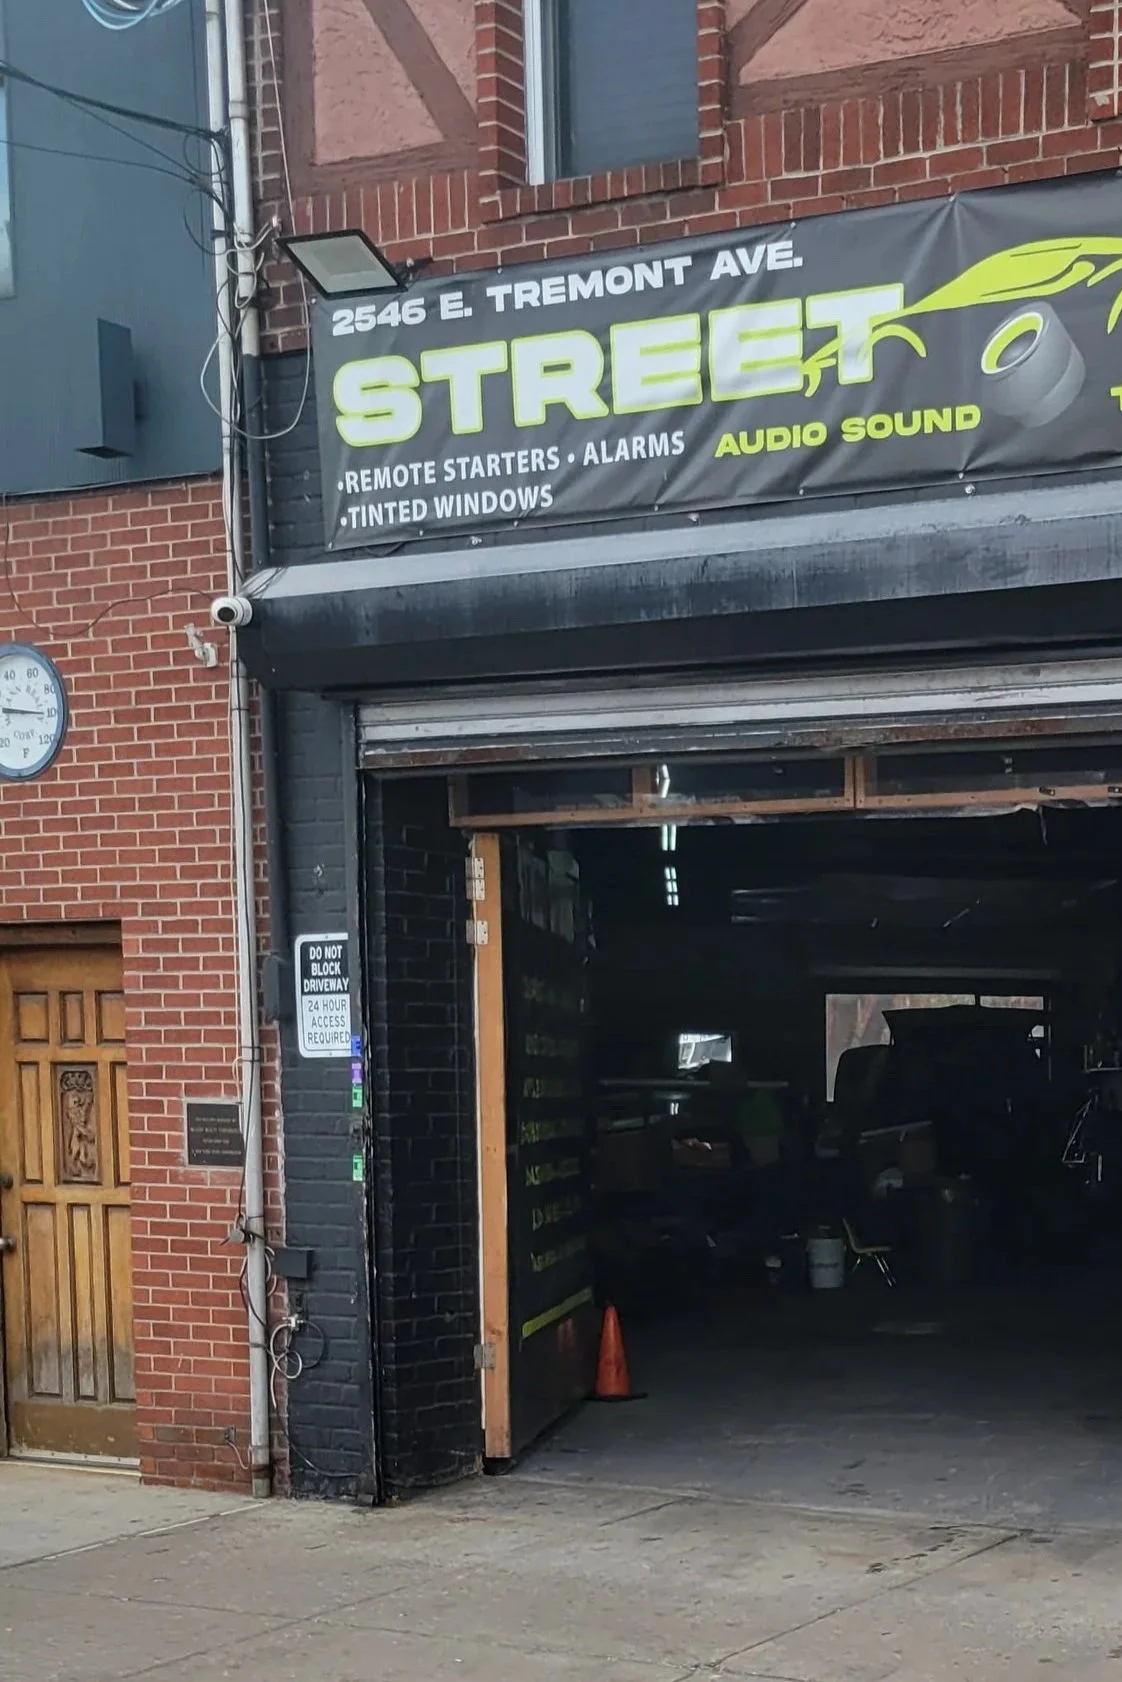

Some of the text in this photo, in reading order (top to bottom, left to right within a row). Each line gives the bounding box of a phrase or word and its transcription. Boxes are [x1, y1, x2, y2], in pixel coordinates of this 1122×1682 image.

[332, 239, 803, 336] 2546 E. TREMONT AVE.
[333, 282, 905, 448] STREET
[715, 405, 981, 458] AUDIO SOUND
[345, 431, 685, 494] REMOTE STARTERS ALARMS
[347, 485, 553, 529] TINTED WINDOWS
[4, 667, 39, 681] 40 60
[309, 945, 343, 960] DO NOT
[311, 962, 341, 976] BLOCK
[303, 978, 350, 993] DRIVEWAY
[308, 999, 347, 1012] 24 HOUR
[311, 1015, 346, 1028] ACCESS
[307, 1030, 351, 1044] REQUIRED
